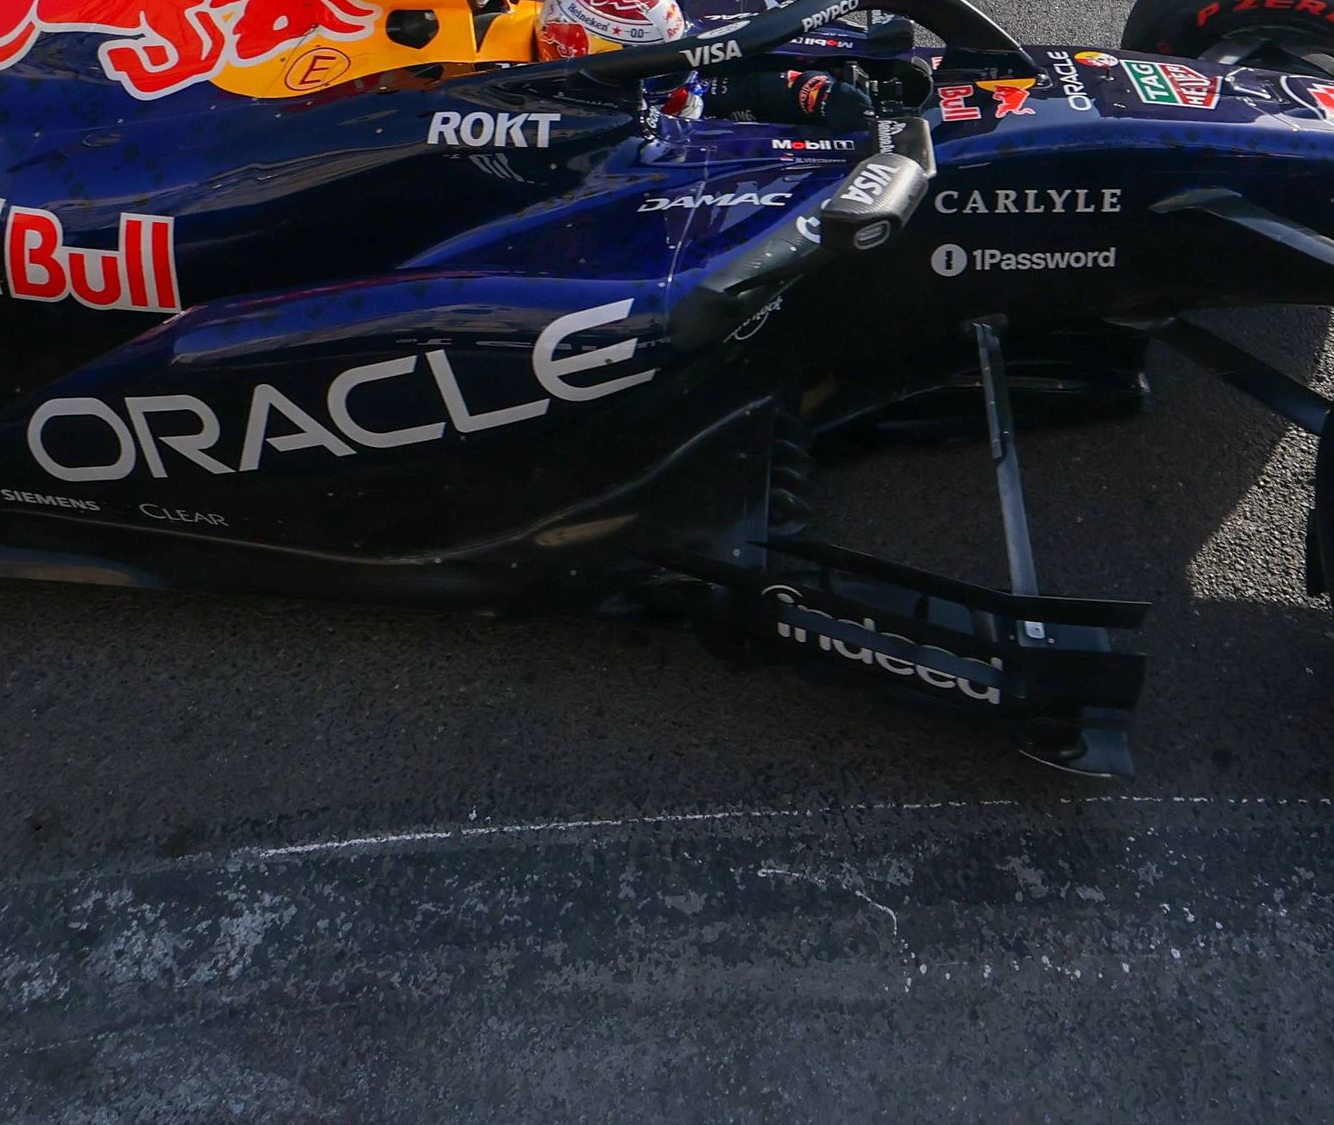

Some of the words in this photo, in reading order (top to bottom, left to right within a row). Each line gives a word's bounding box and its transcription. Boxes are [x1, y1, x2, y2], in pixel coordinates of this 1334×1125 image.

[1196, 1, 1224, 26] P
[679, 40, 742, 68] VISA
[1048, 51, 1094, 111] ORACLE
[1132, 63, 1169, 101] TAG
[1166, 64, 1213, 106] HEUER
[938, 85, 982, 122] Bull
[427, 111, 561, 148] ROKT
[771, 139, 832, 151] Mobil
[840, 163, 897, 205] VISA
[637, 191, 792, 213] DAMAC
[934, 188, 1123, 214] CARLYLE
[4, 206, 181, 313] Bull
[971, 246, 1117, 272] 1Password
[26, 297, 658, 482] ORACLE
[0, 487, 102, 513] SIEMENS
[139, 502, 230, 527] CLEAR
